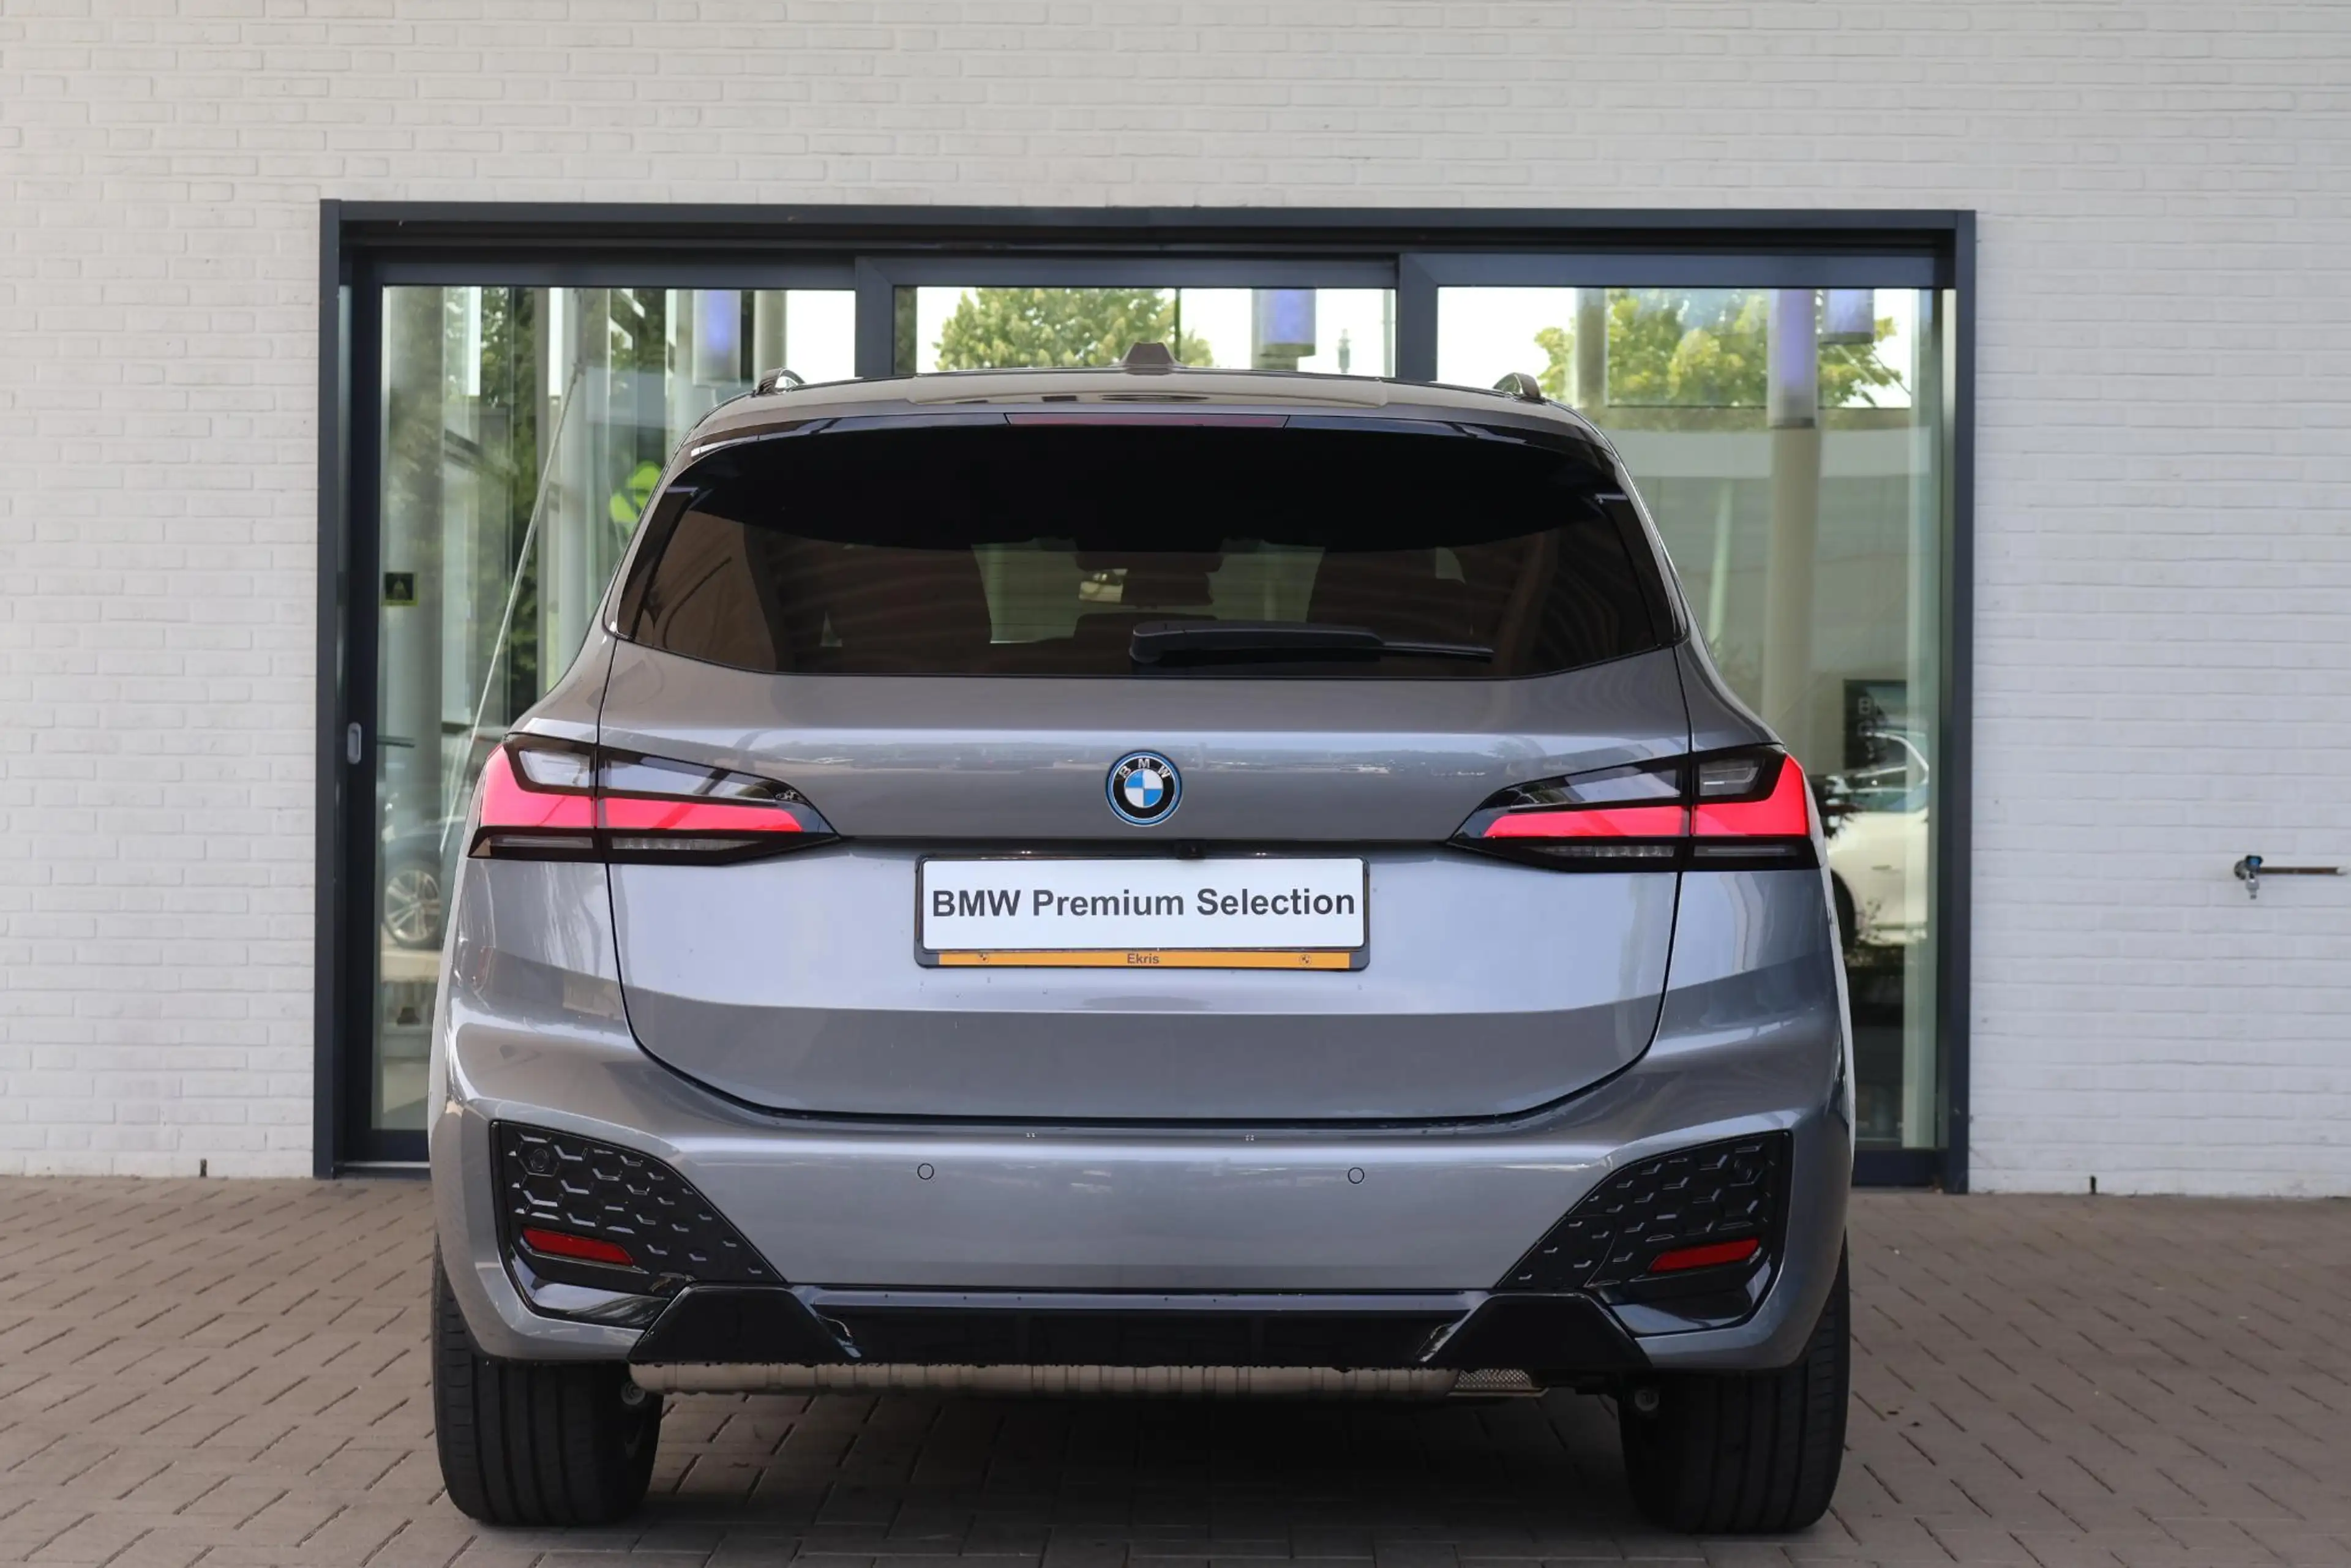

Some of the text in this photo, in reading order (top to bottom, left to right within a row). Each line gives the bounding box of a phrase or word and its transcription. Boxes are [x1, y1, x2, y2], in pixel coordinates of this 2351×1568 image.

[1118, 758, 1171, 779] BMW
[932, 888, 1355, 917] BMW Premium Selection
[1127, 953, 1160, 964] Ekris
